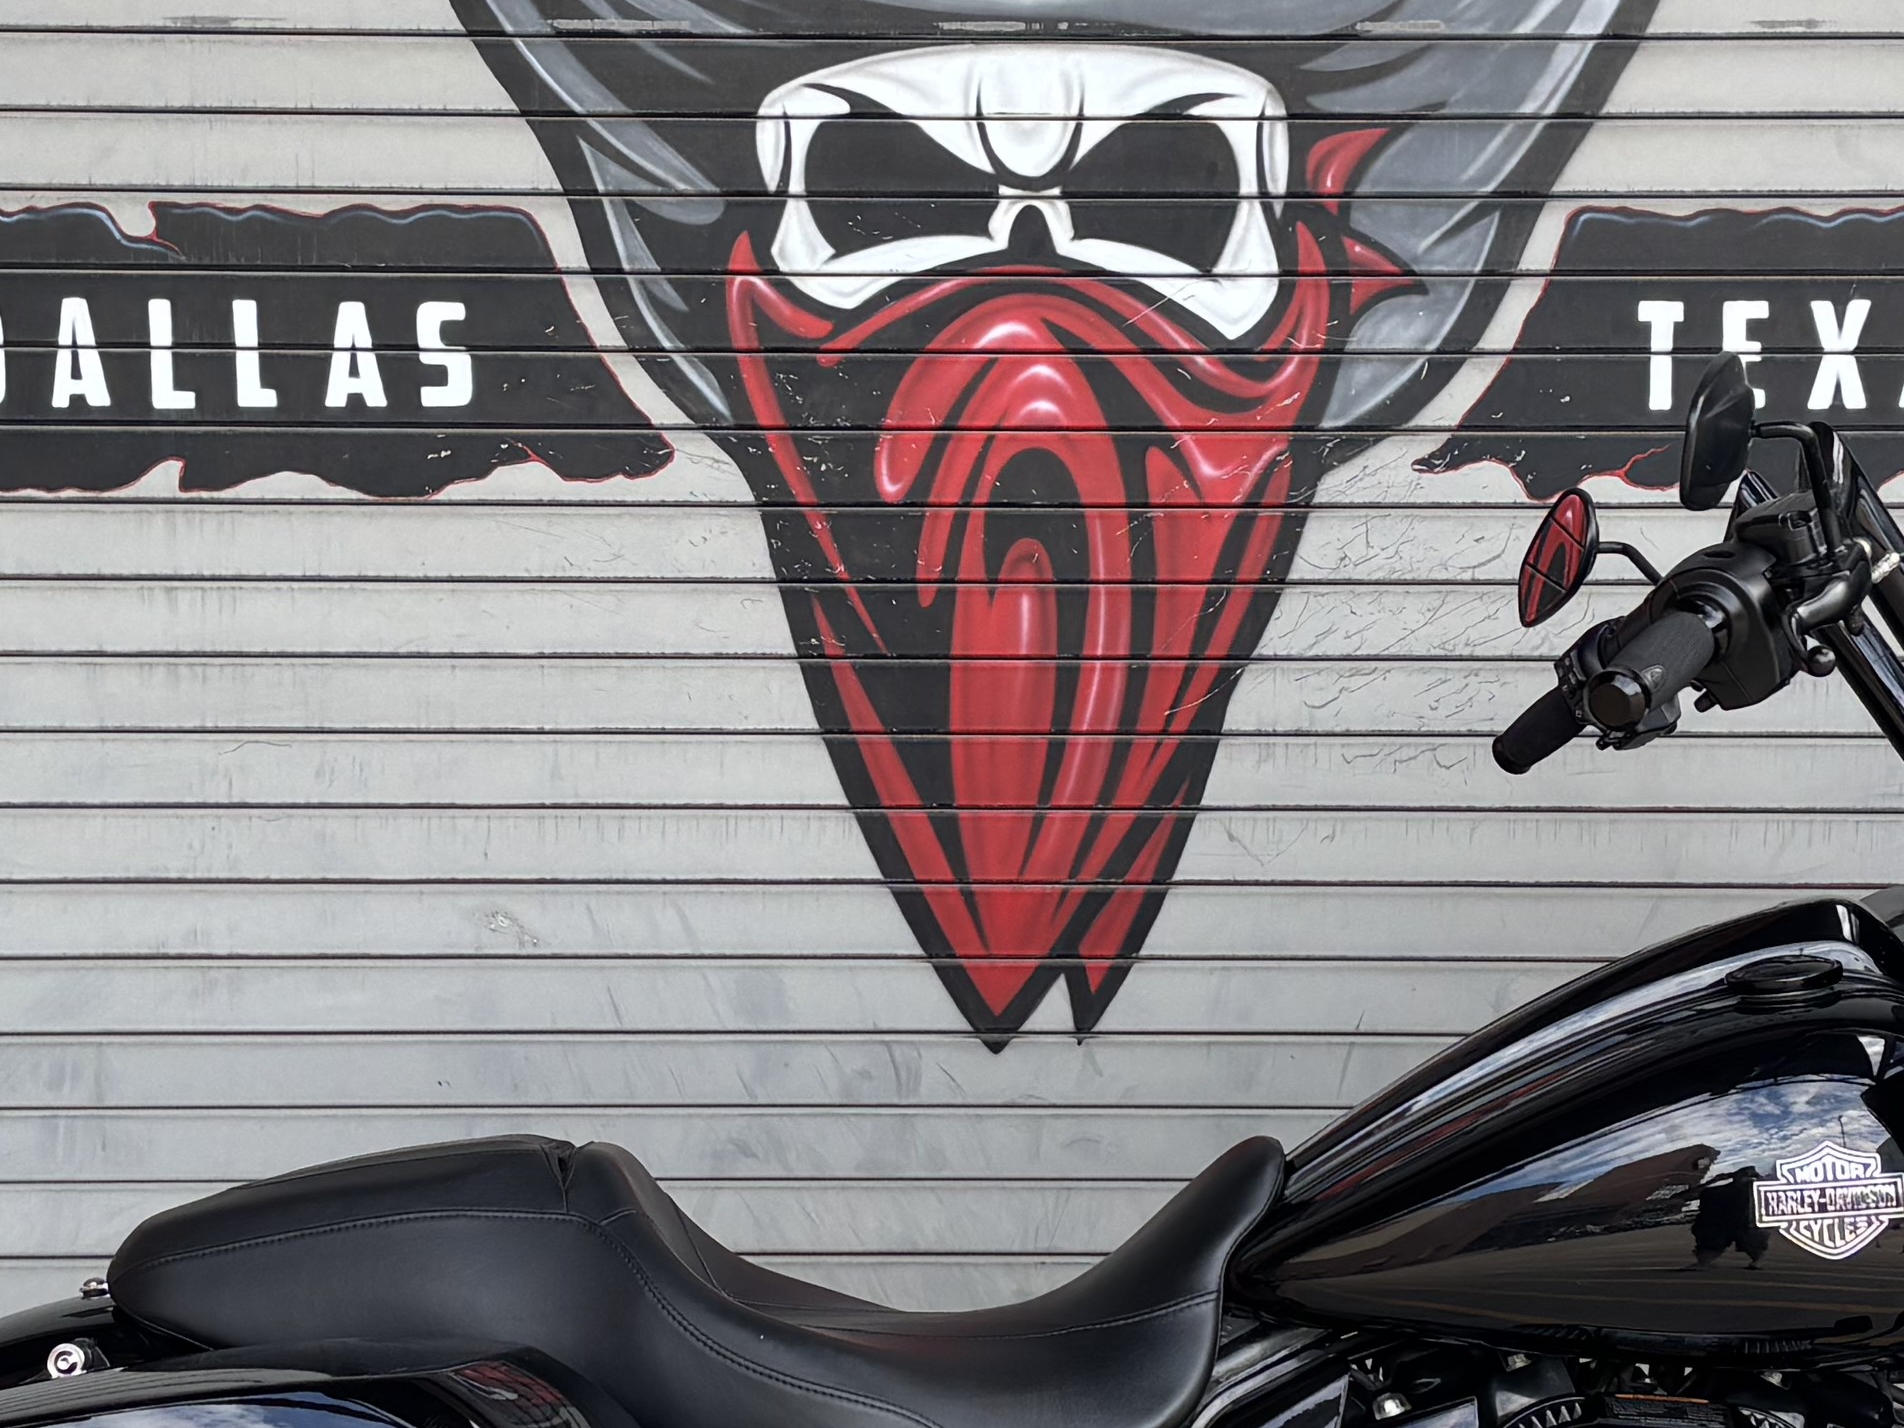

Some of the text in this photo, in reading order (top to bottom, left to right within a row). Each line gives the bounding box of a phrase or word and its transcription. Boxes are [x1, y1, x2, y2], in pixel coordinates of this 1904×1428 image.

[1794, 1154, 1866, 1184] MOTOR
[1765, 1183, 1896, 1216] HARLEY-DAVIDSON
[1798, 1215, 1870, 1249] CYCLES
